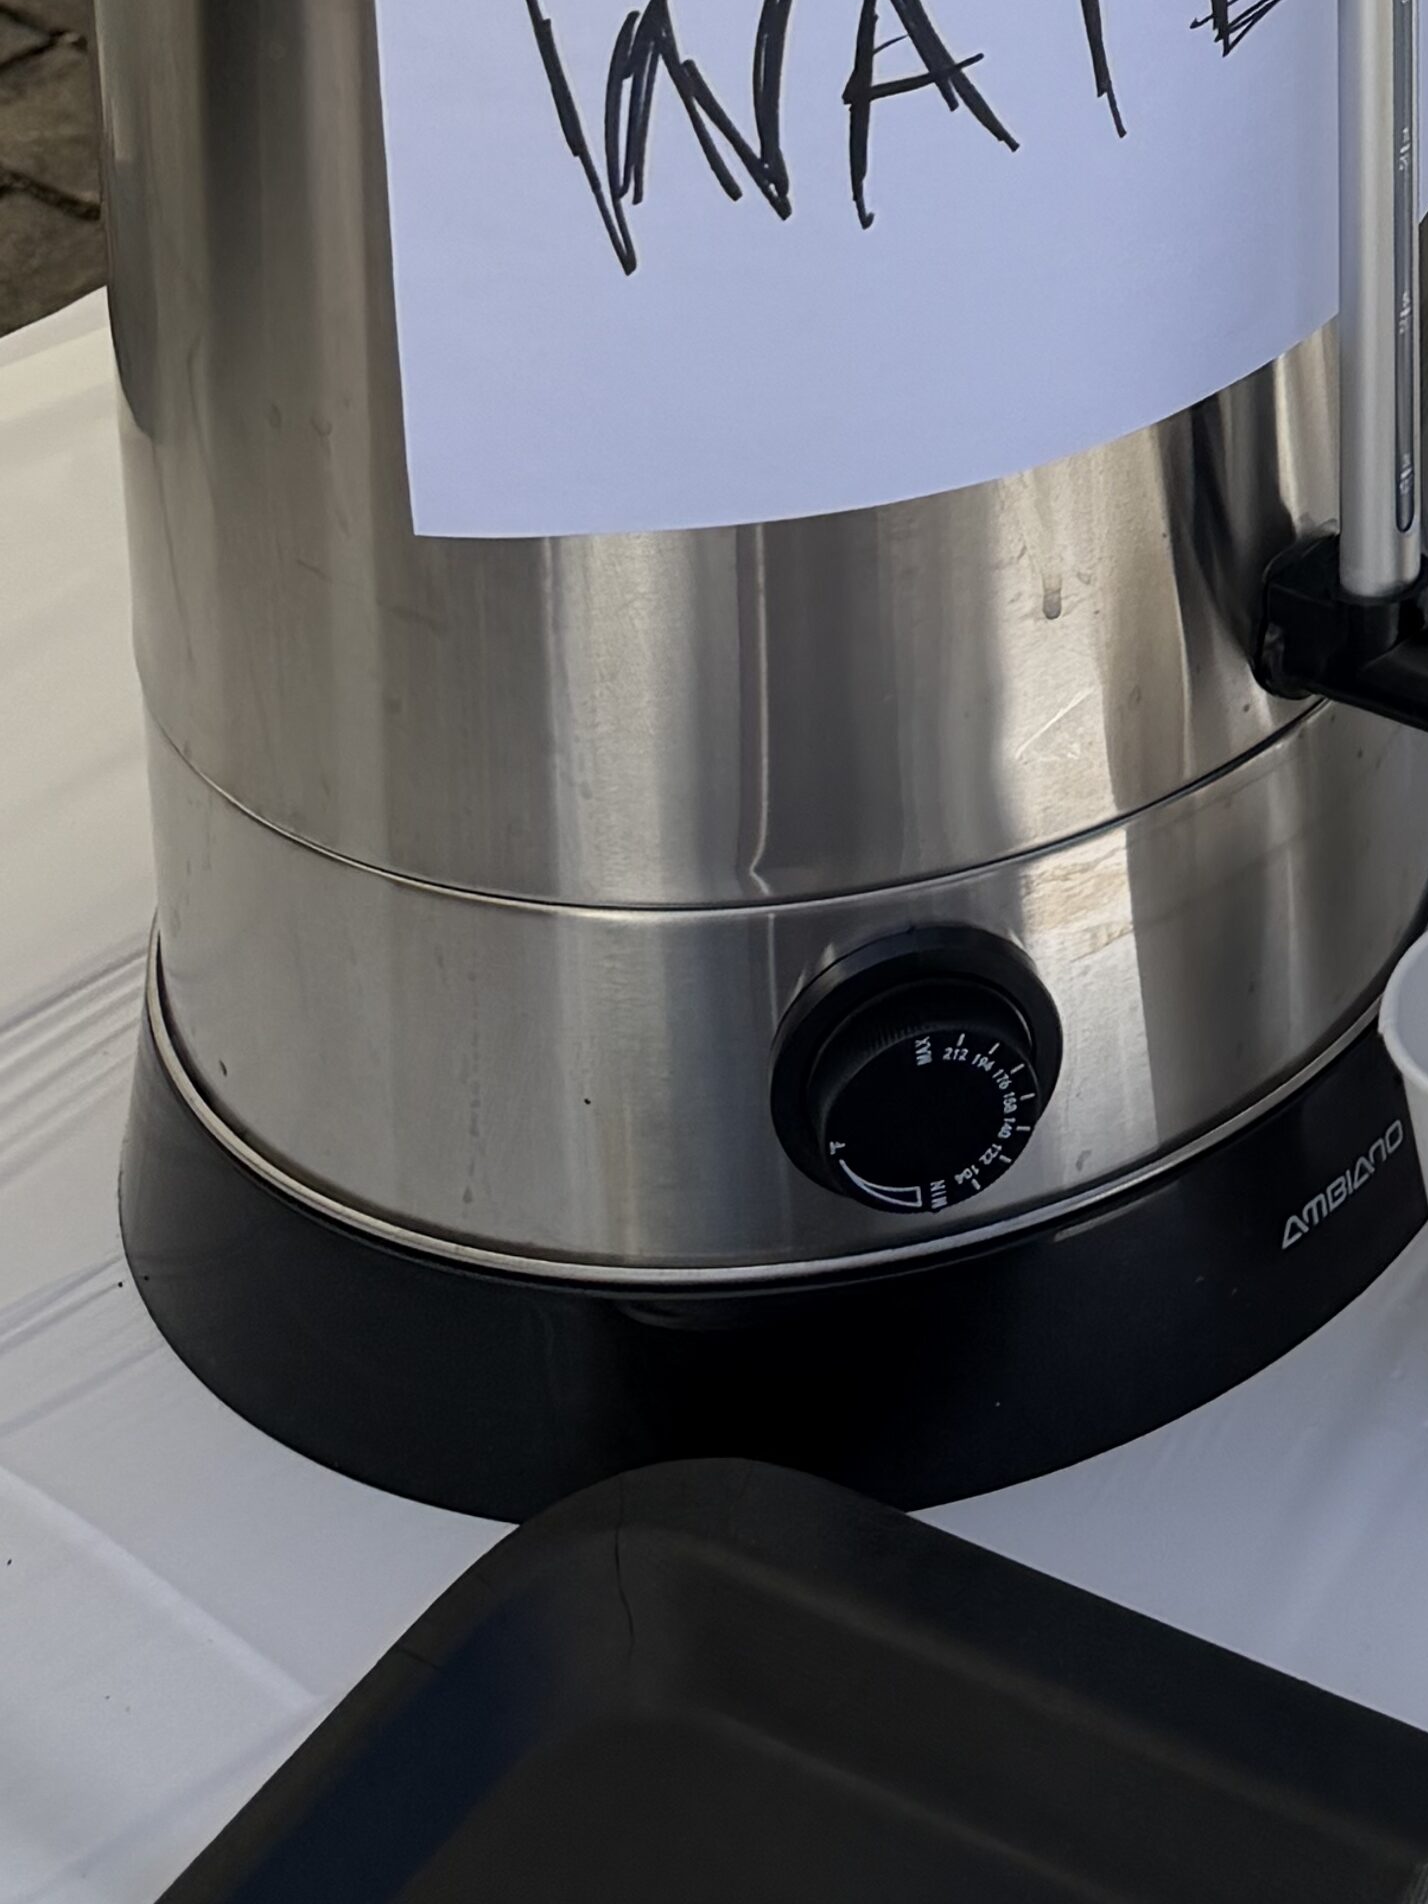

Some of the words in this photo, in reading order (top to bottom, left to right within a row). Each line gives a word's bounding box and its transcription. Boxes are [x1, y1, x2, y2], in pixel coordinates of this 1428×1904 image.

[914, 1036, 933, 1066] MAX
[942, 1047, 969, 1062] 212
[992, 1068, 1012, 1090] 176
[978, 1143, 1002, 1165] 122
[930, 1179, 948, 1210] MIN
[1281, 1118, 1404, 1251] AMBIANO
